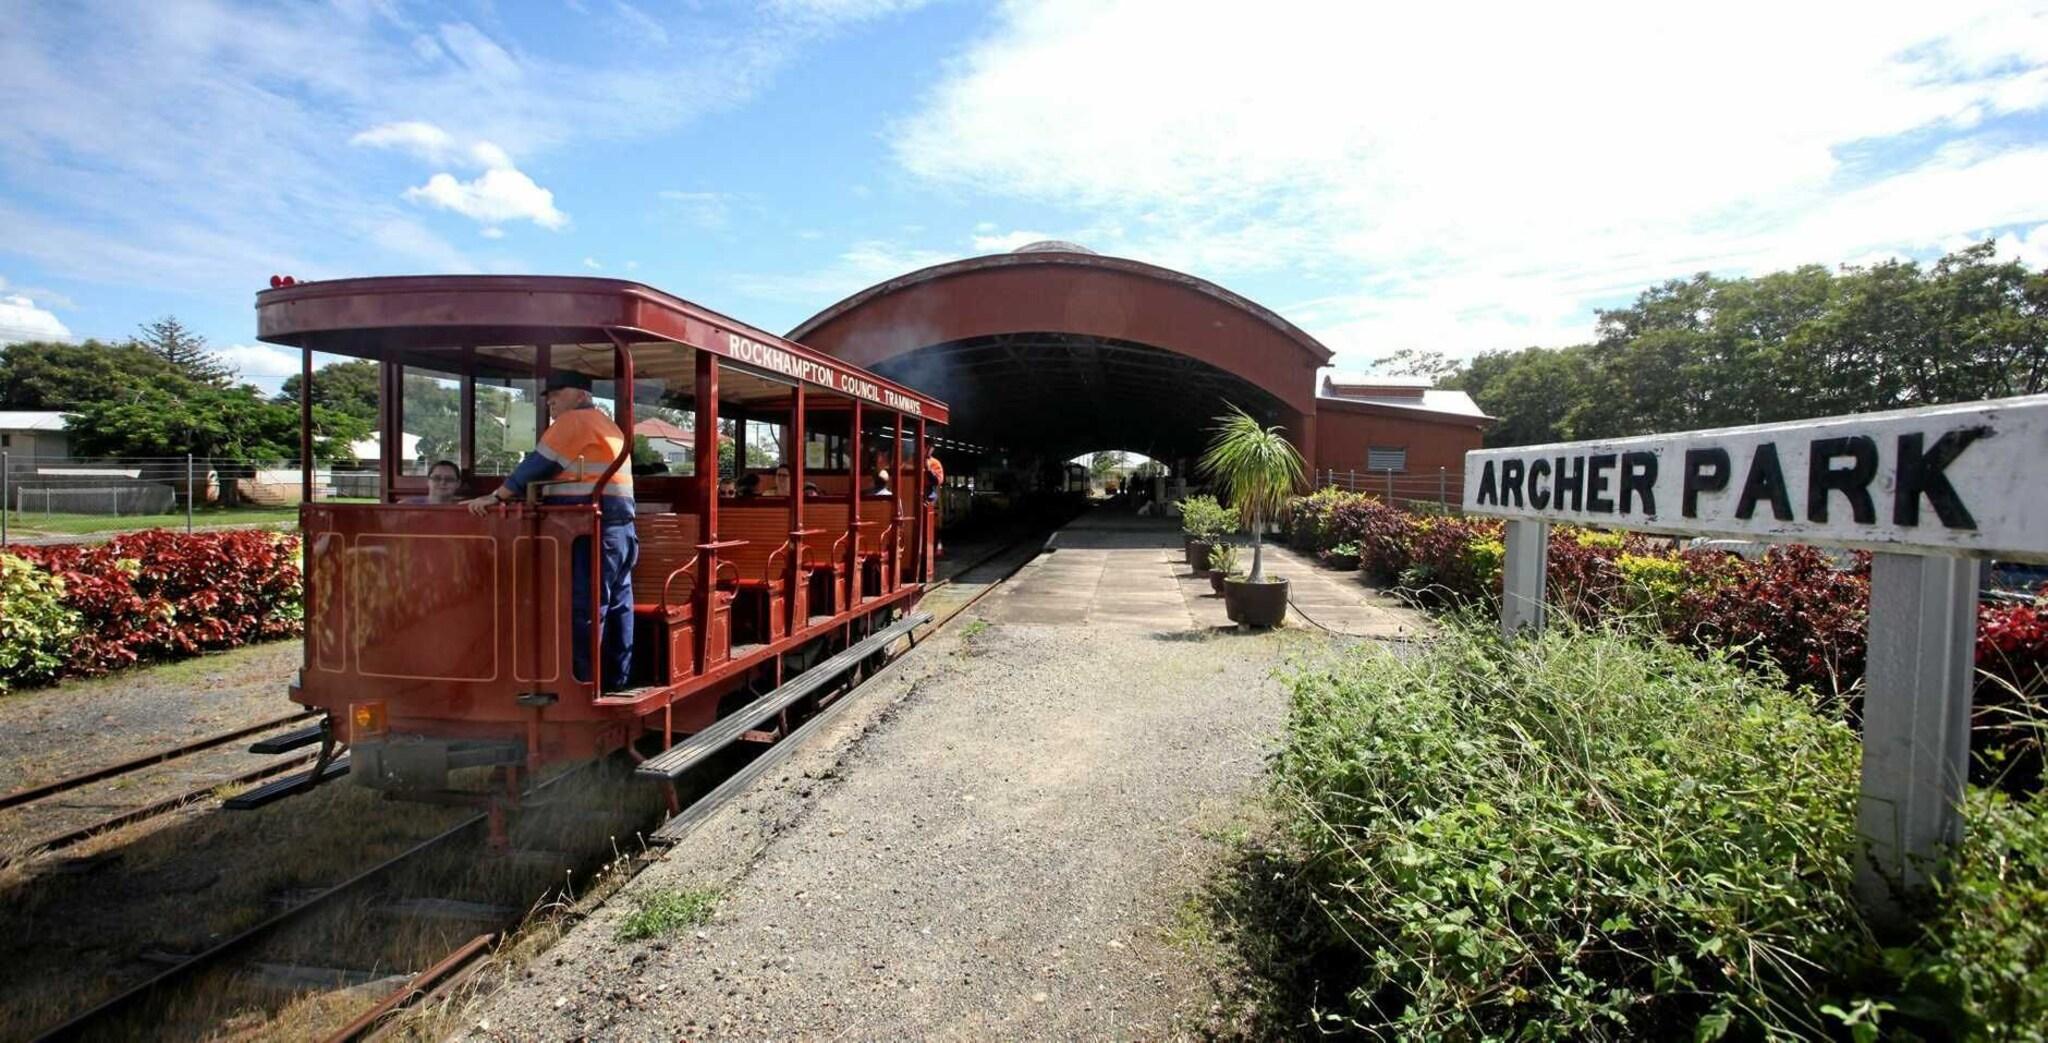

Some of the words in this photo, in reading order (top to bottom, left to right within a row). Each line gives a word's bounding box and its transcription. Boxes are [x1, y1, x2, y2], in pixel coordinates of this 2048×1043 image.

[729, 334, 834, 387] ROCKHAMPTON
[841, 375, 880, 402] COUNCIL
[1477, 450, 1659, 516] ARCHER
[1682, 424, 1996, 530] PARK
